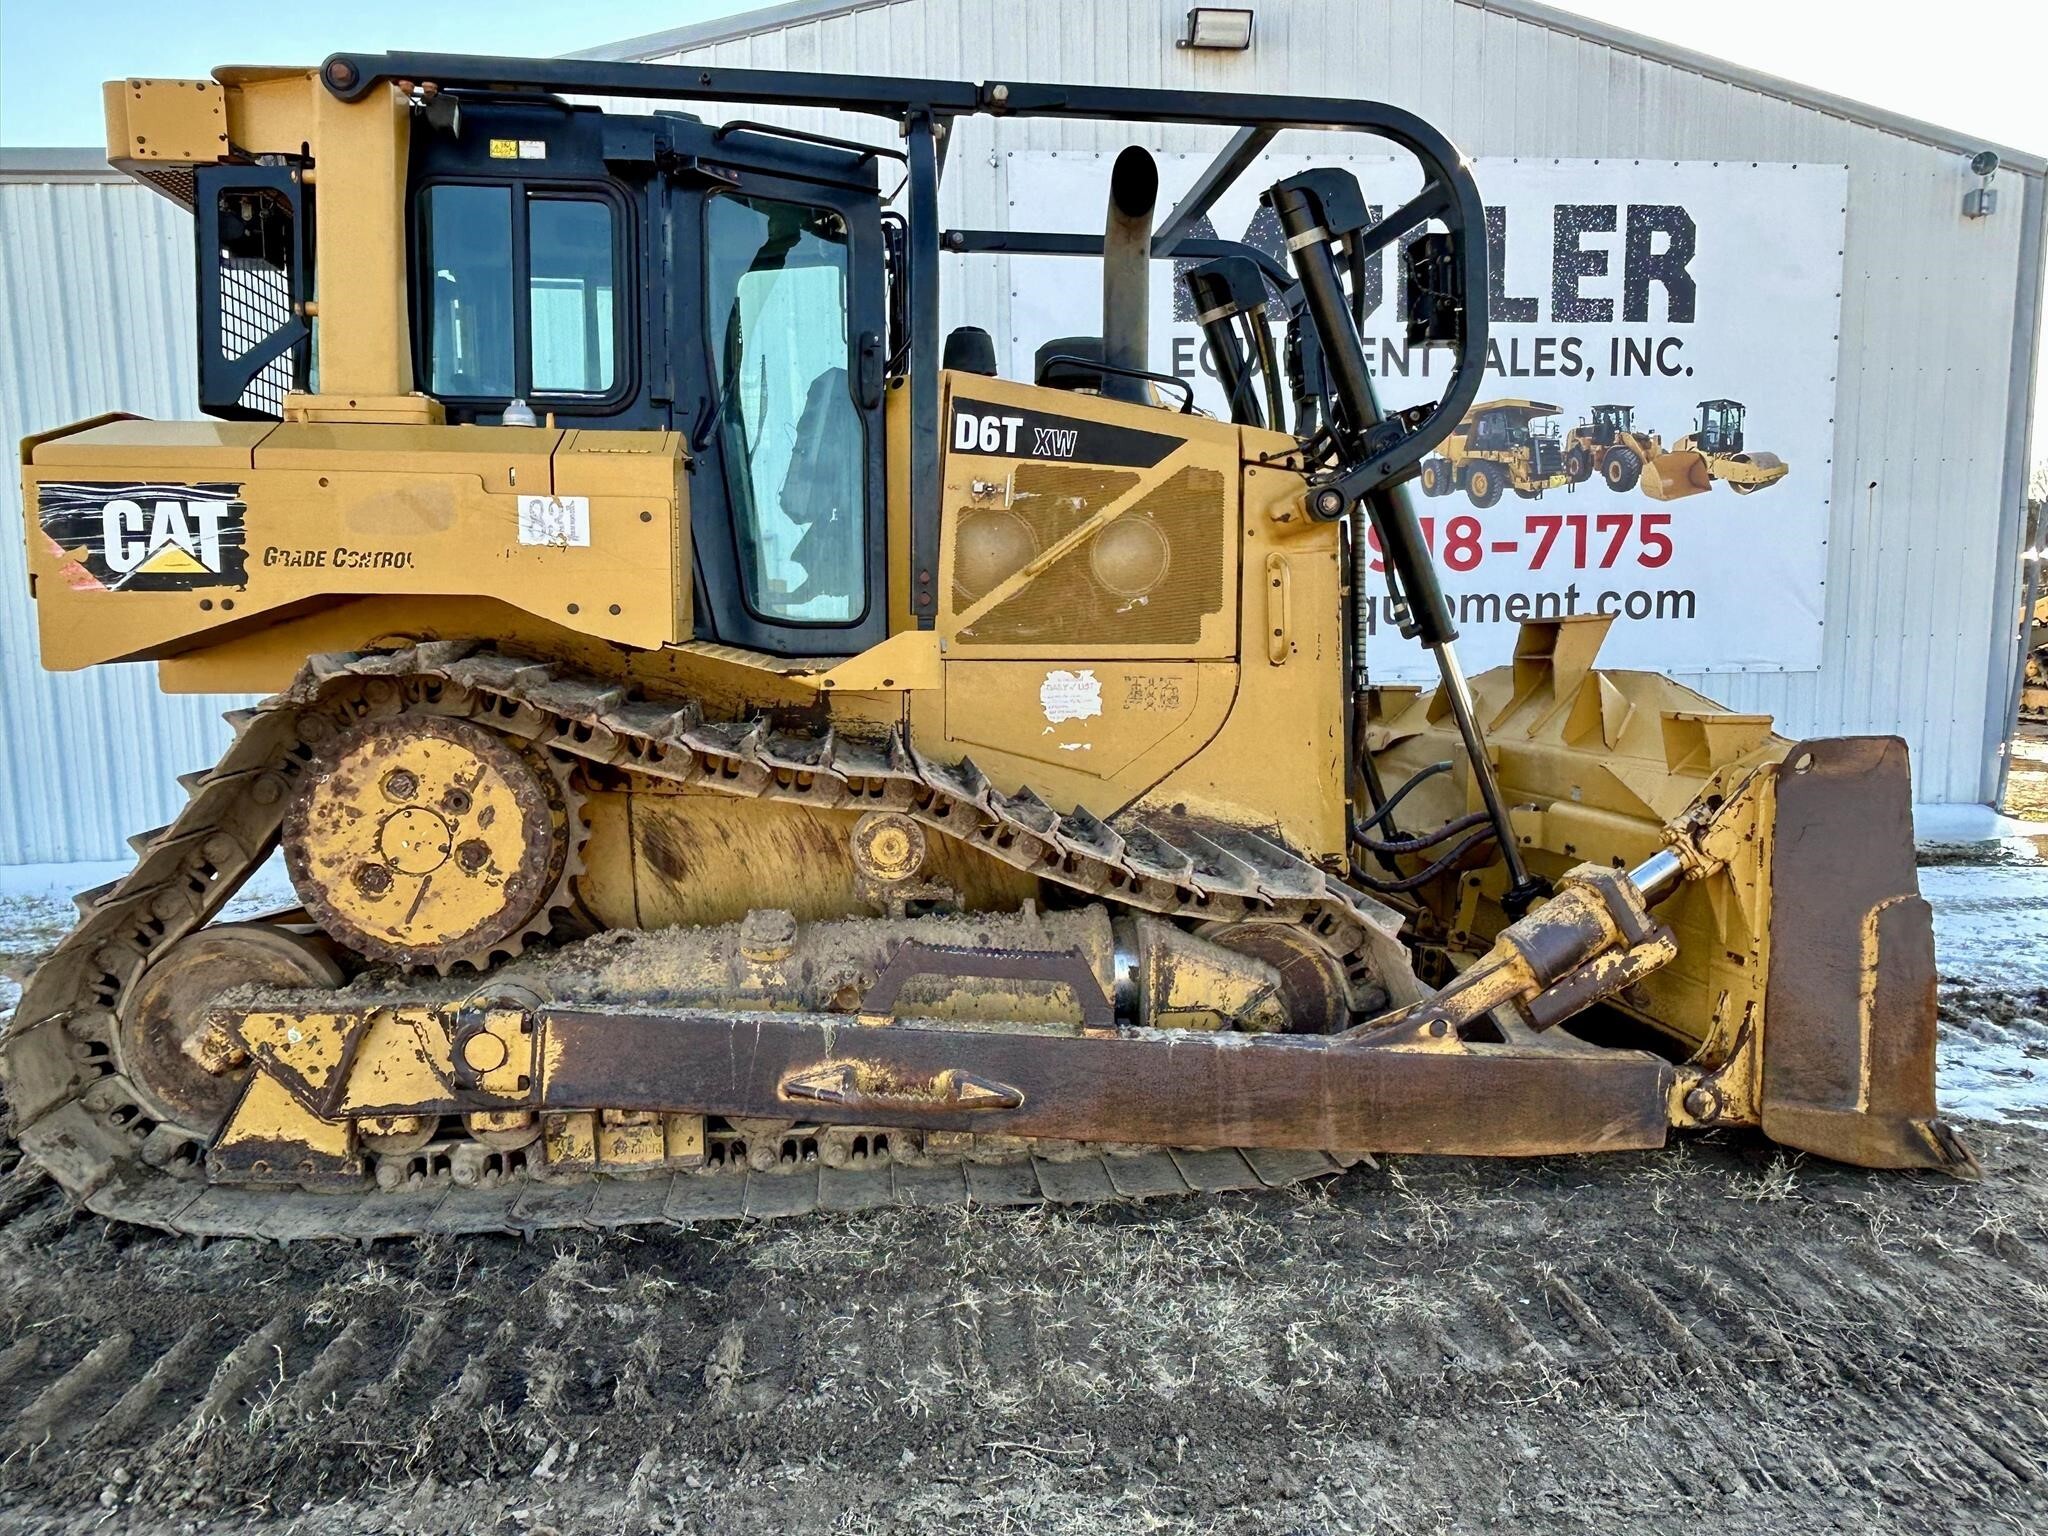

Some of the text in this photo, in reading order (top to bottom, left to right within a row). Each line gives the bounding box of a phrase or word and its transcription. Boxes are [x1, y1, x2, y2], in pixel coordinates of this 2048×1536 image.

[1173, 204, 1697, 323] MLER
[1483, 337, 1595, 382] ALES,
[1610, 336, 1694, 377] INC.
[955, 413, 1078, 458] D6T XW
[102, 499, 229, 574] CAT
[263, 546, 327, 567] GRADE
